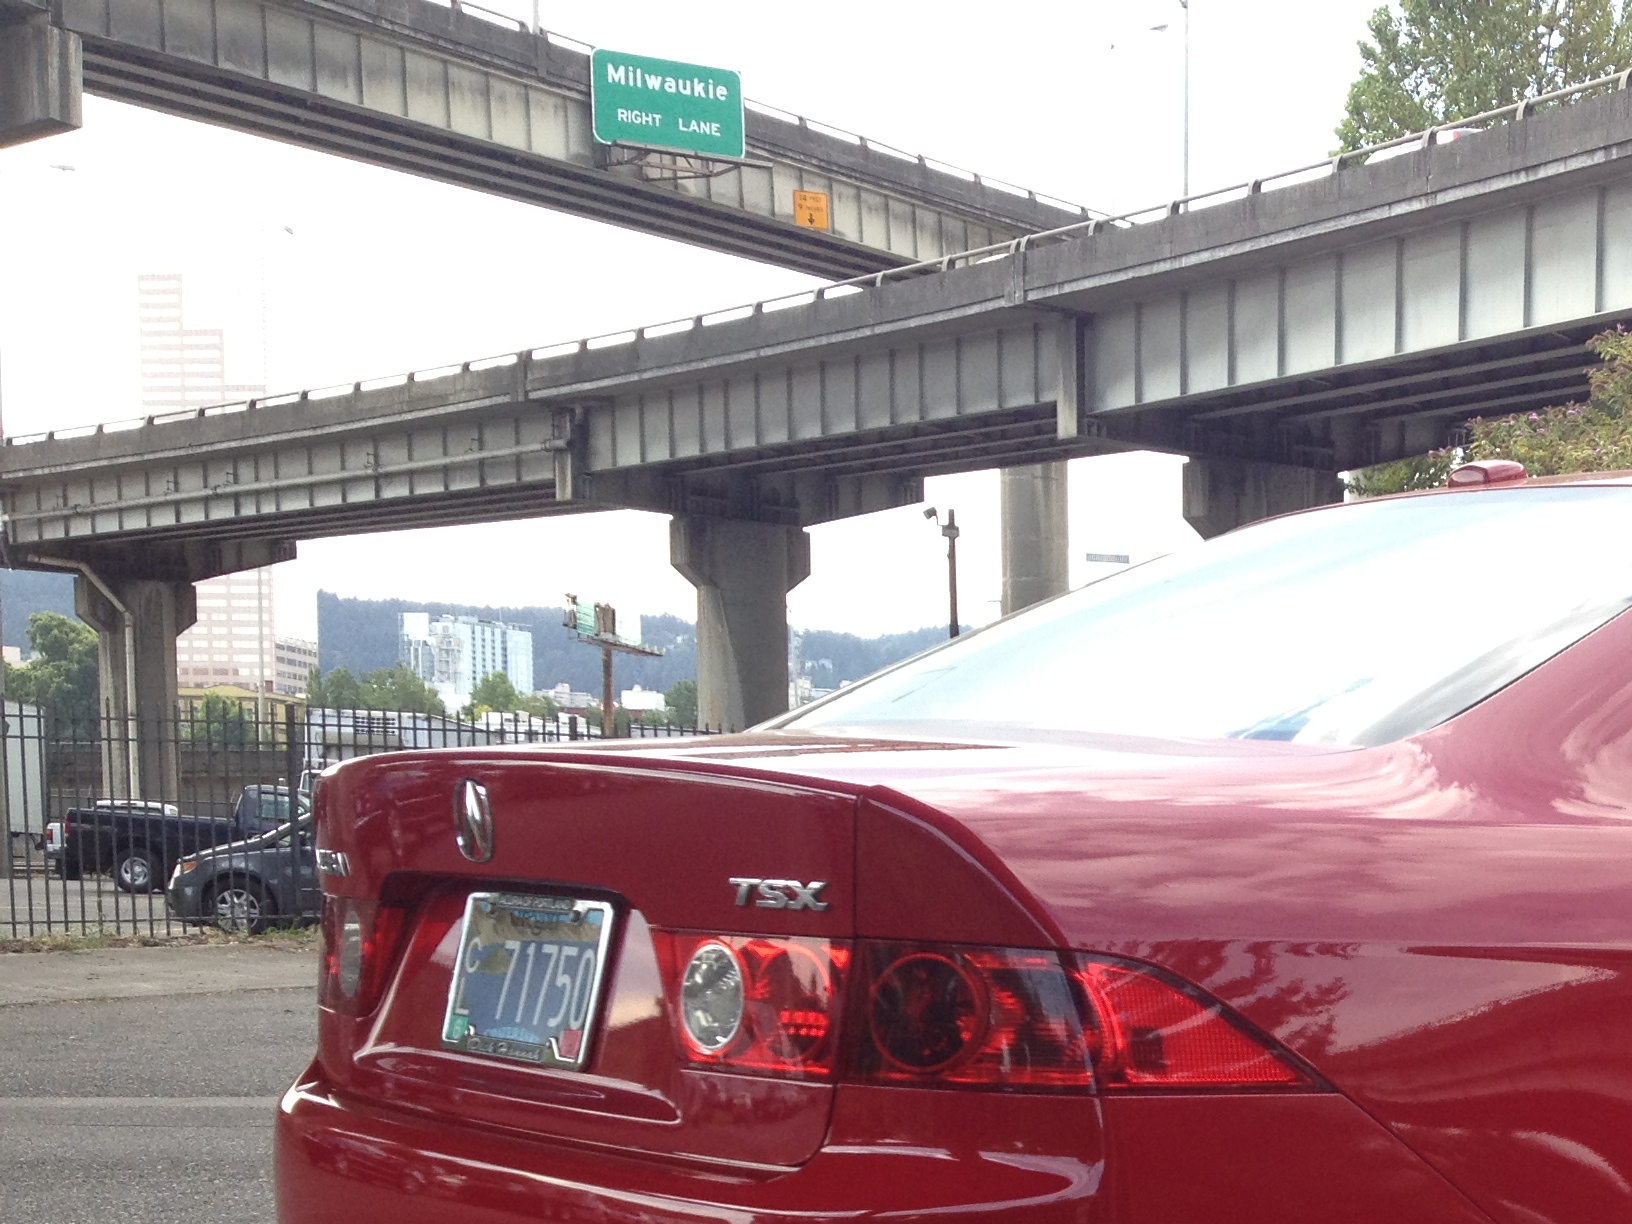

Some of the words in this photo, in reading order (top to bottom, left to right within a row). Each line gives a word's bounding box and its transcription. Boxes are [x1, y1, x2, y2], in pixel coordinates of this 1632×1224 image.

[606, 62, 728, 101] Milwaukie
[617, 108, 662, 127] RIGHT
[678, 118, 721, 136] LANE
[728, 877, 829, 912] TSX
[494, 939, 596, 1030] 71750
